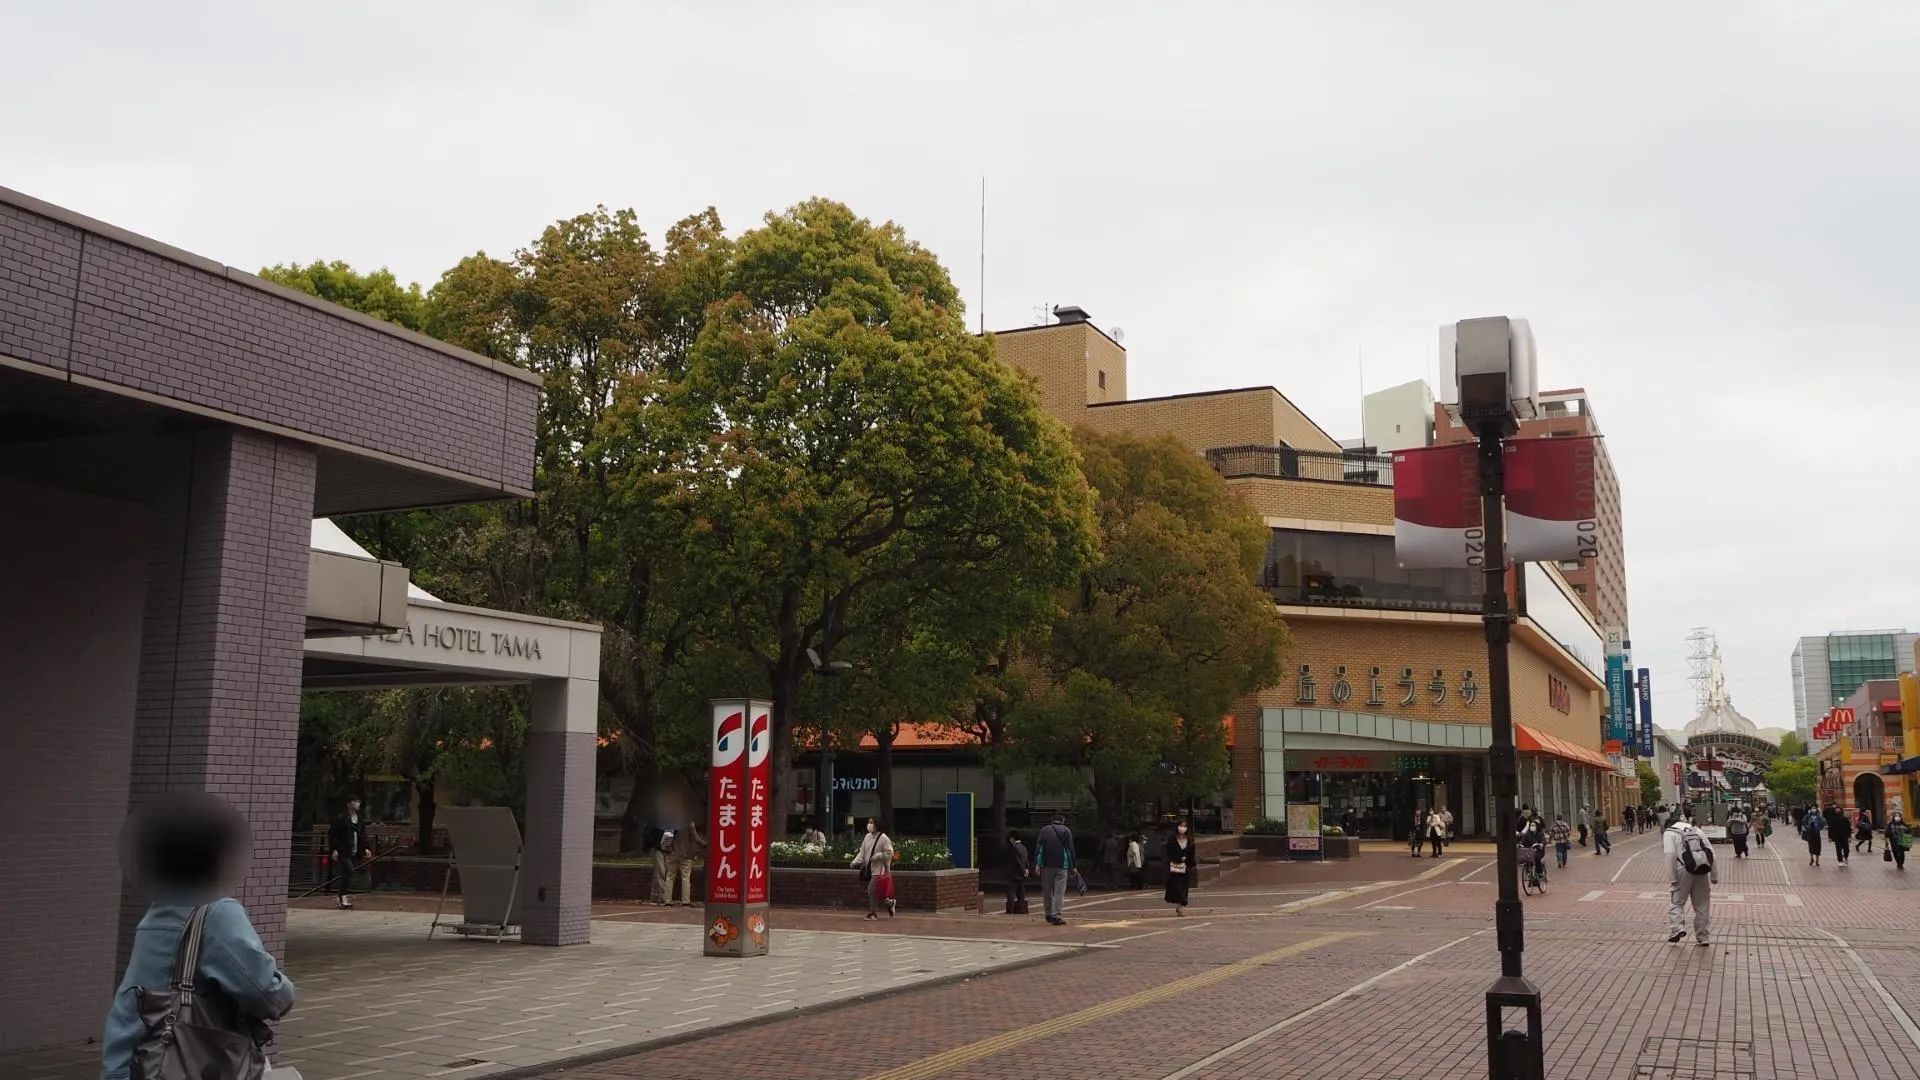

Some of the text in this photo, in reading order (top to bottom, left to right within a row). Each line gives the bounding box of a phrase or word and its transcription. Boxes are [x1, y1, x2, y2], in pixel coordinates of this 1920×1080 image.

[1460, 453, 1484, 567] OKYO 2020
[1574, 446, 1598, 558] OKYO 2020
[423, 623, 486, 654] HOTEL
[491, 631, 542, 661] TAMA
[1297, 672, 1479, 706] 丘の上プラザ
[717, 776, 737, 879] たましん
[749, 777, 764, 879] たましん
